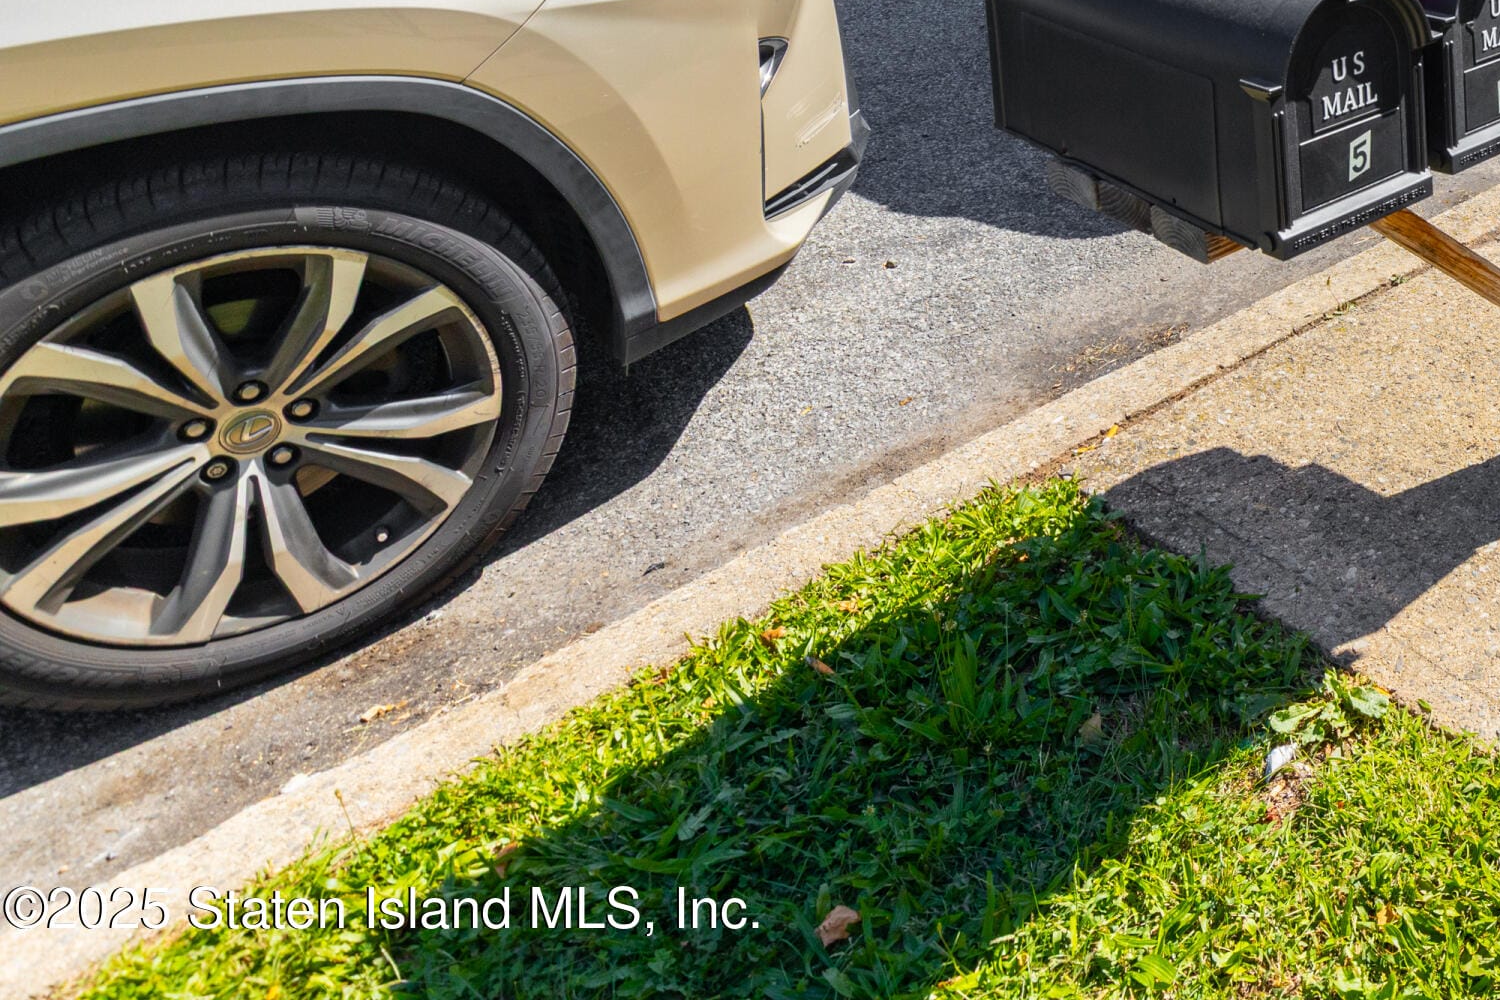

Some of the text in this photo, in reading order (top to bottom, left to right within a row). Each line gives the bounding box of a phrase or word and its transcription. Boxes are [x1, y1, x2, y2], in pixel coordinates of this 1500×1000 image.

[1322, 81, 1378, 121] MAIL
[1351, 139, 1369, 173] 5
[377, 217, 514, 299] MICHELIN
